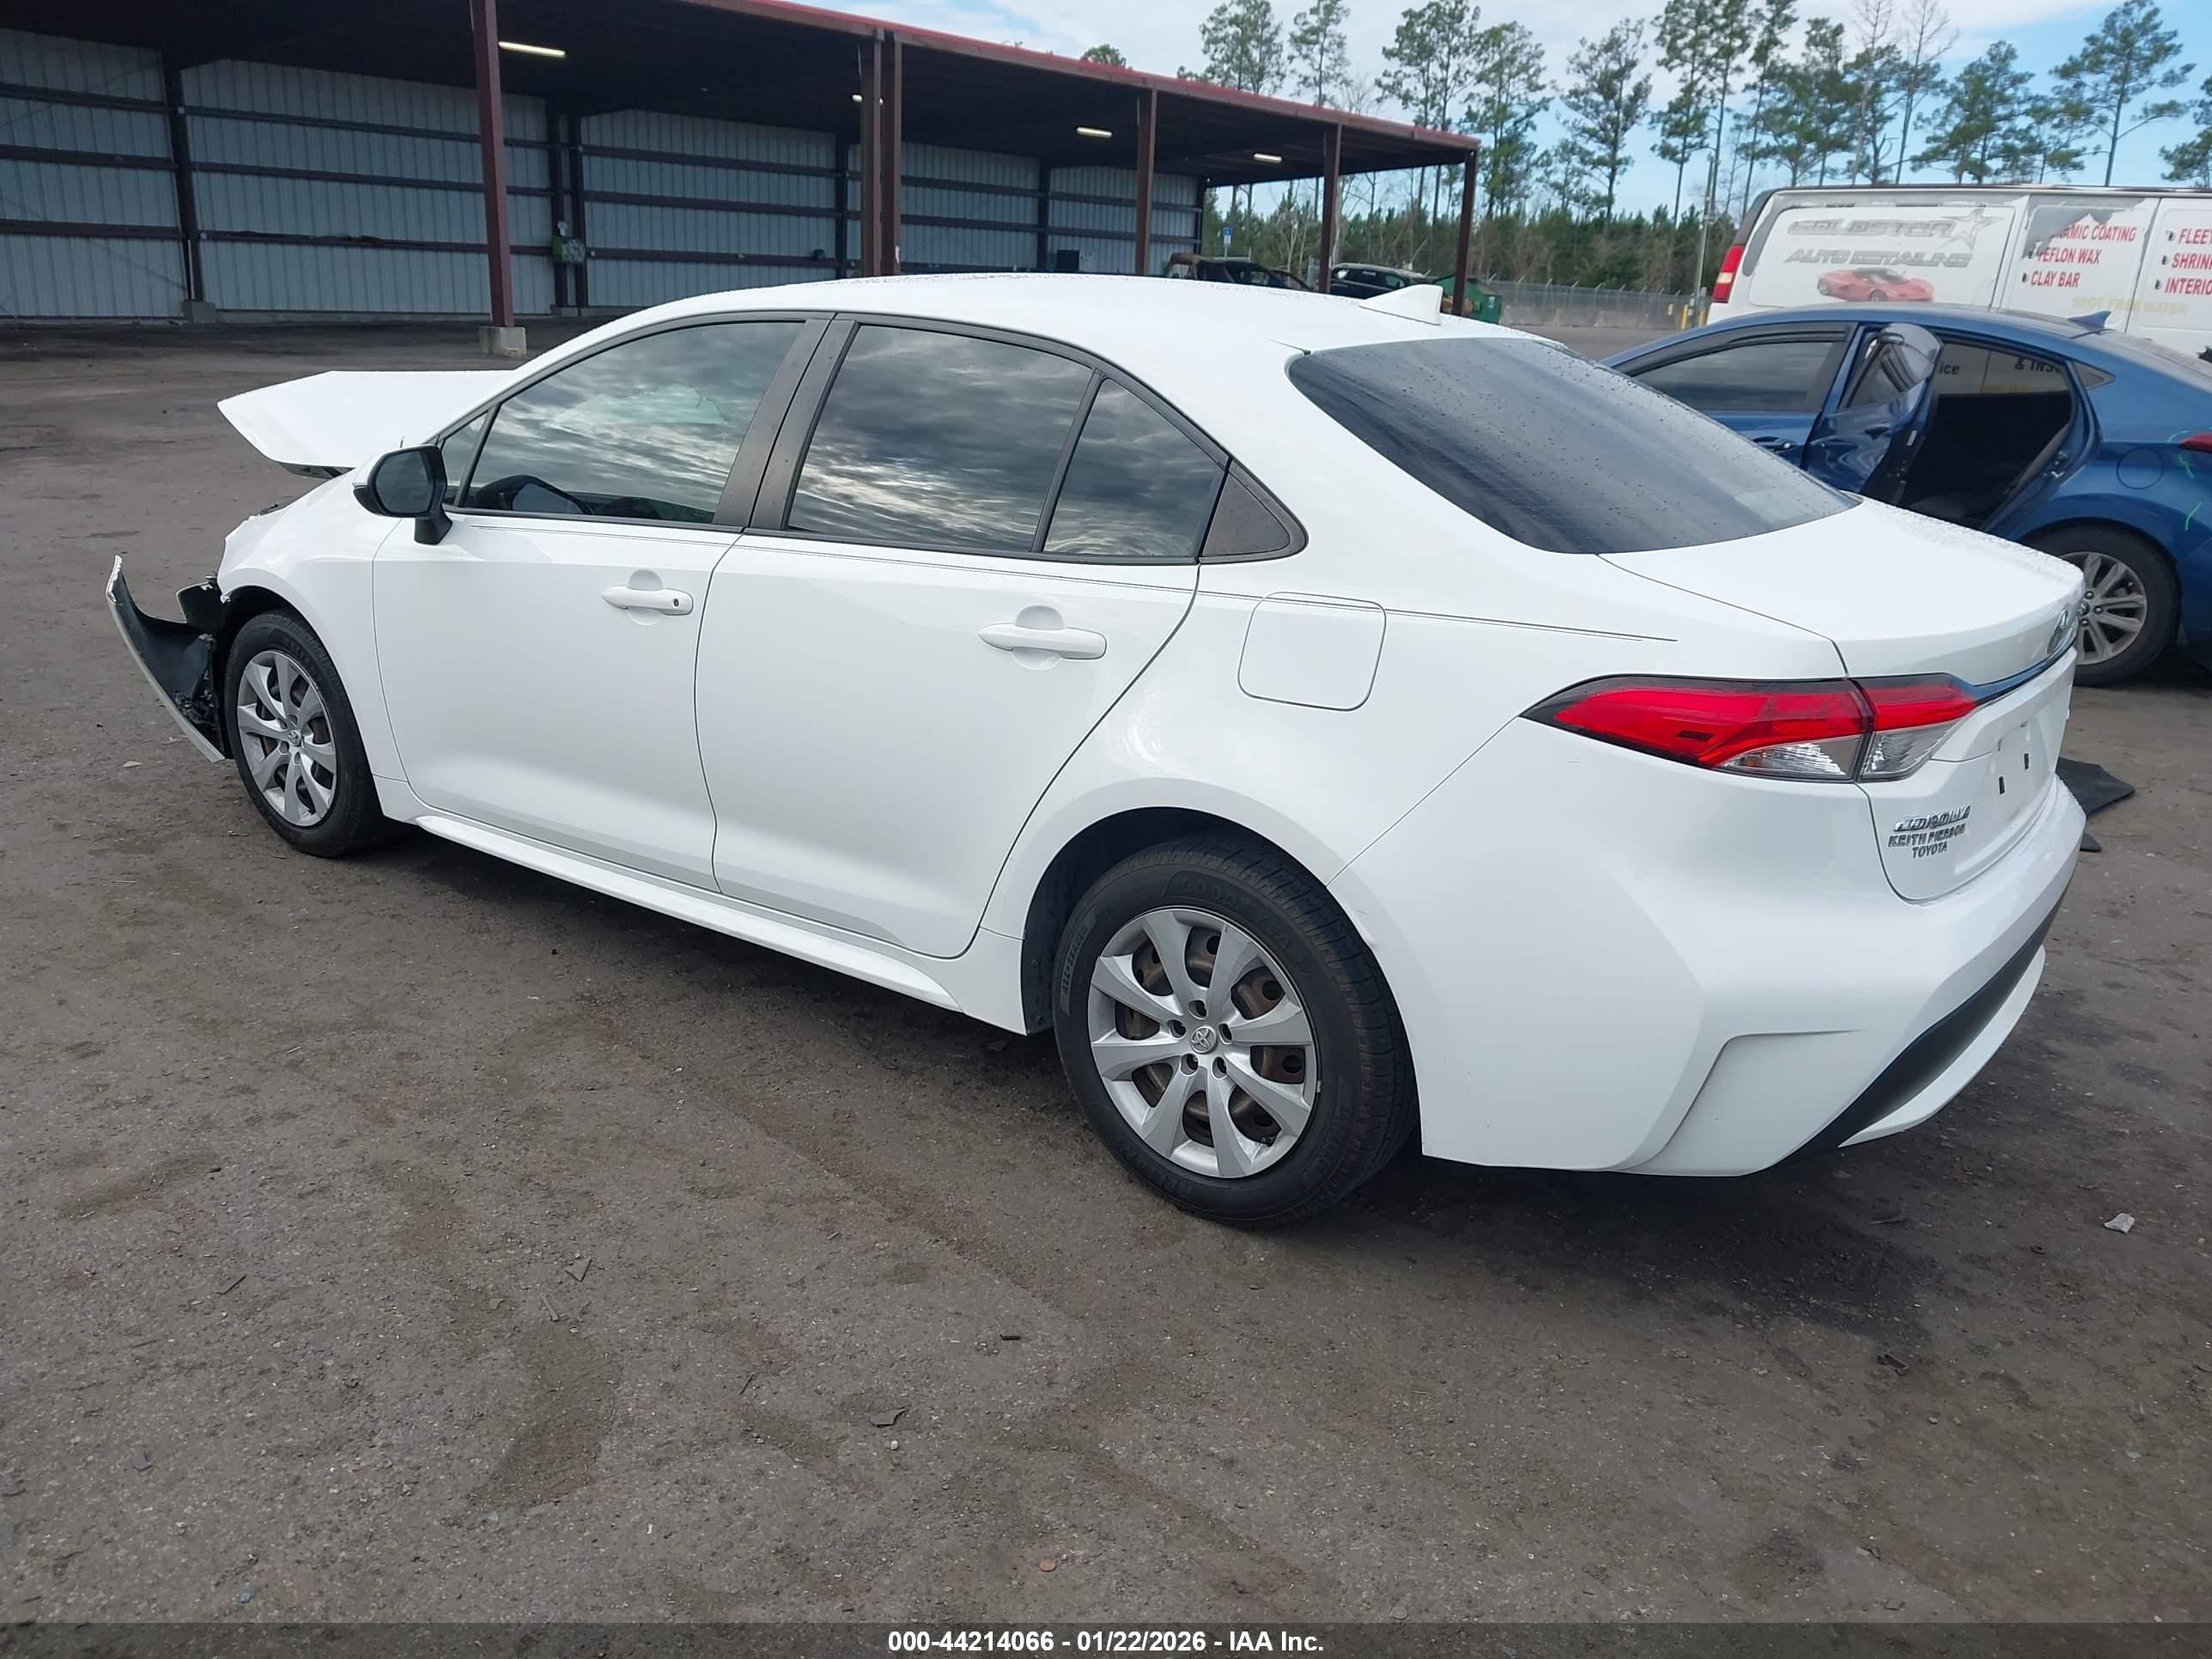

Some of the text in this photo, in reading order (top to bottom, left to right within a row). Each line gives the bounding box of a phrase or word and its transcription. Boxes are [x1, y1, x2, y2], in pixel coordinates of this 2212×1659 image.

[2091, 226, 2137, 242] COATING
[1785, 248, 1972, 268] AUTO DETAILING
[2078, 249, 2102, 265] WAX
[2031, 270, 2081, 288] CLAY BAR
[1938, 362, 1960, 375] ice
[1888, 832, 1928, 848] KEITH
[1911, 841, 1948, 860] TOYOTA
